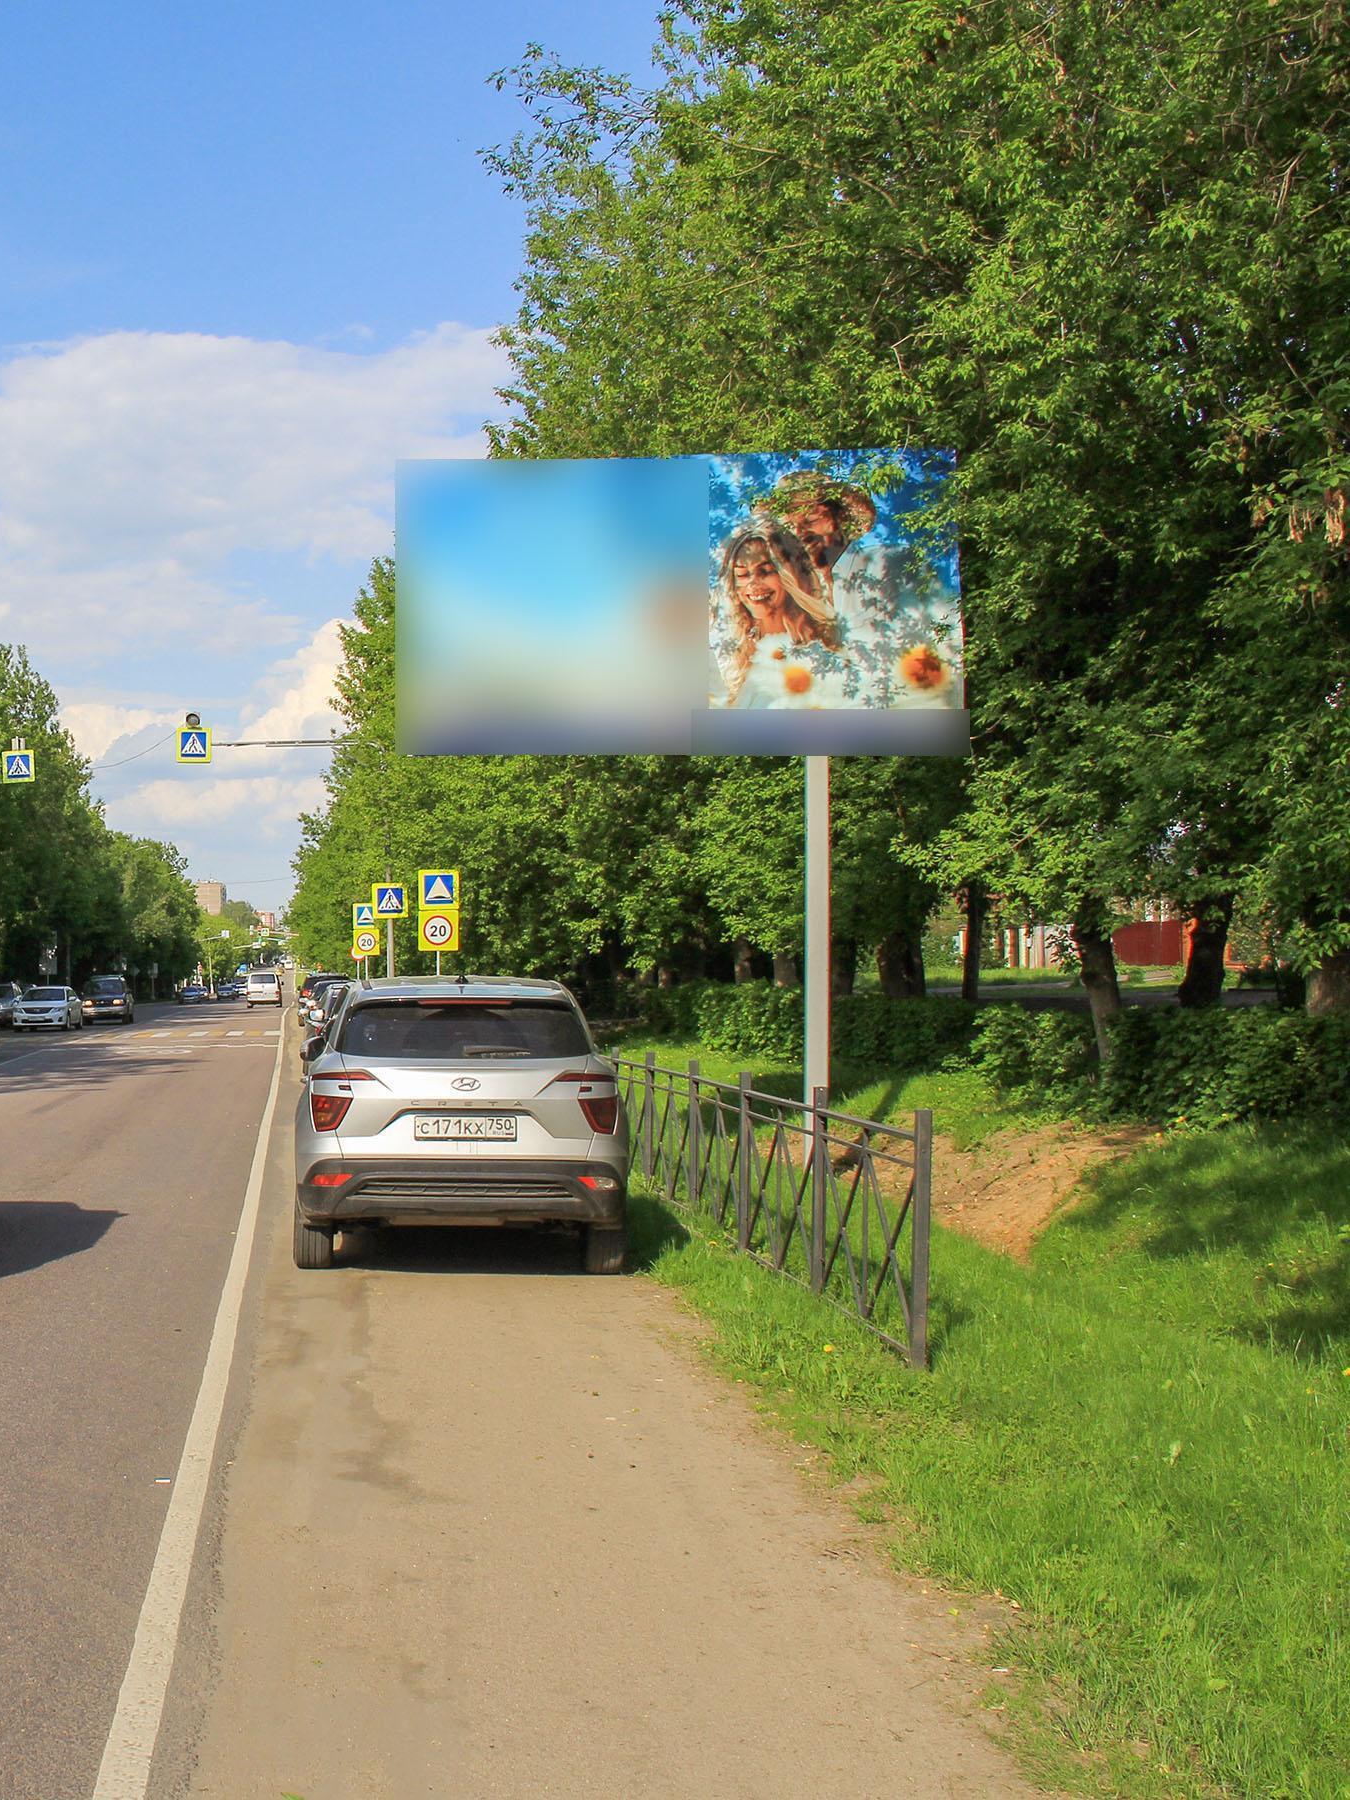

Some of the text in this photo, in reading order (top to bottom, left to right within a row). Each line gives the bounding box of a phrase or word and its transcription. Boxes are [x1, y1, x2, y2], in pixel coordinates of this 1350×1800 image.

[430, 925, 447, 937] 20
[361, 938, 372, 947] 20
[487, 1118, 512, 1131] 750
